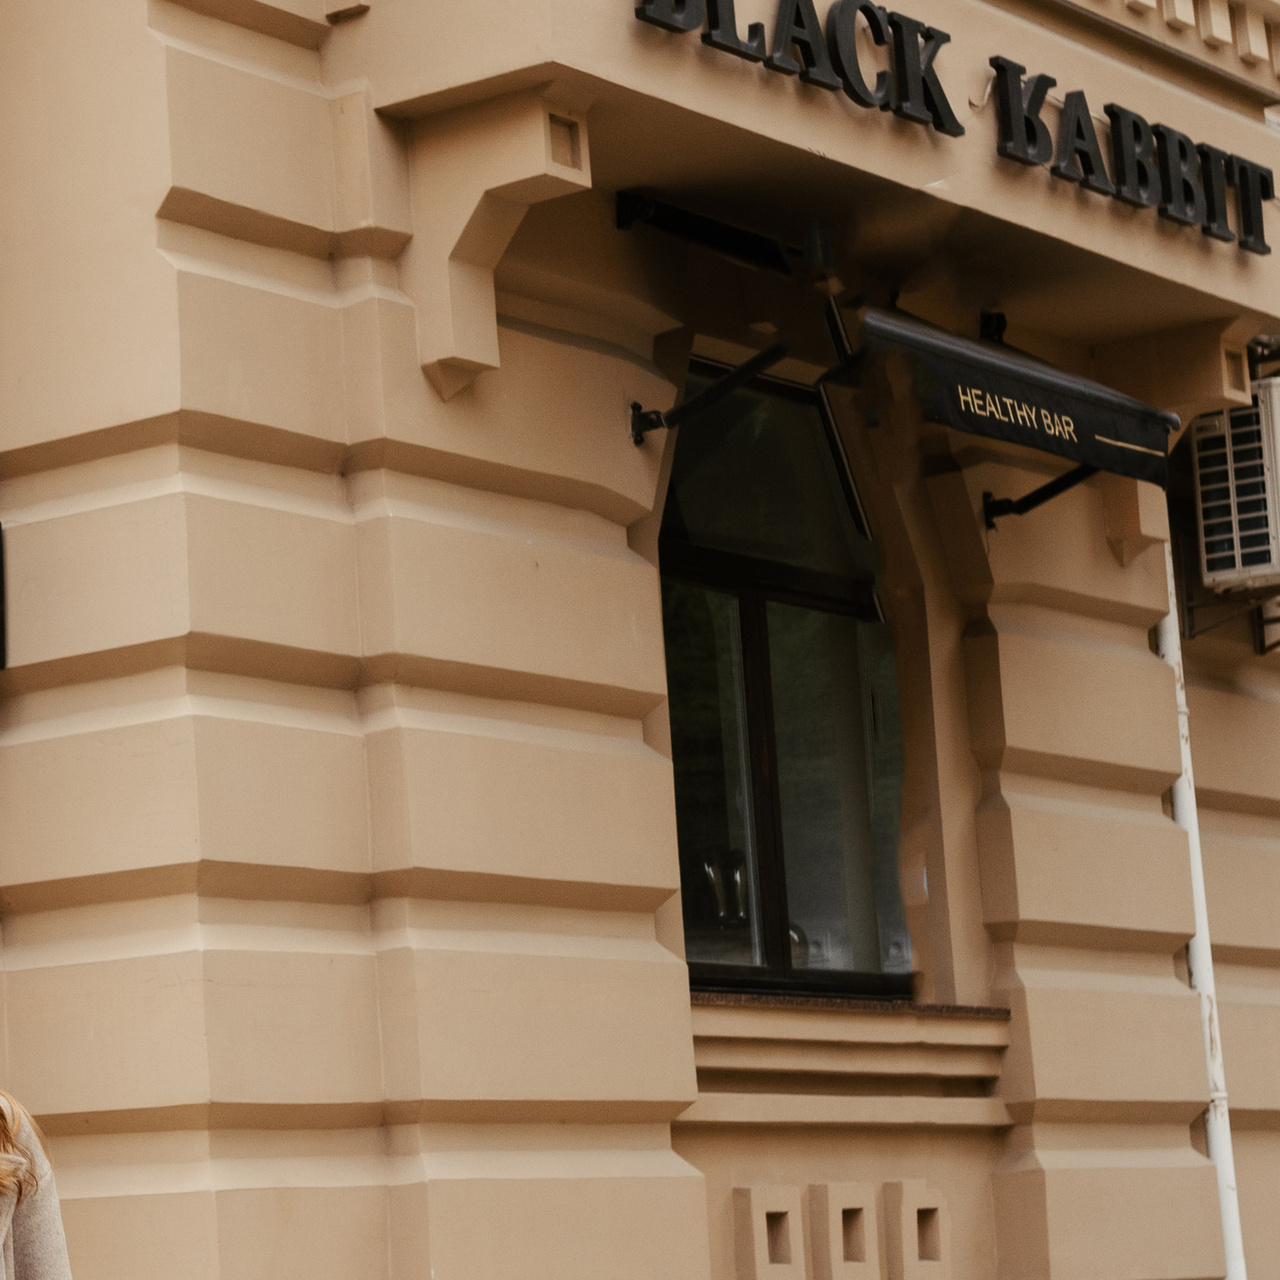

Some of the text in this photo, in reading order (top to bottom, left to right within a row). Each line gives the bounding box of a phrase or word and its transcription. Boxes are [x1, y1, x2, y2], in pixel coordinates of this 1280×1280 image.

[989, 55, 1274, 256] RABBIT
[958, 386, 1078, 443] HEALTHY BAR
